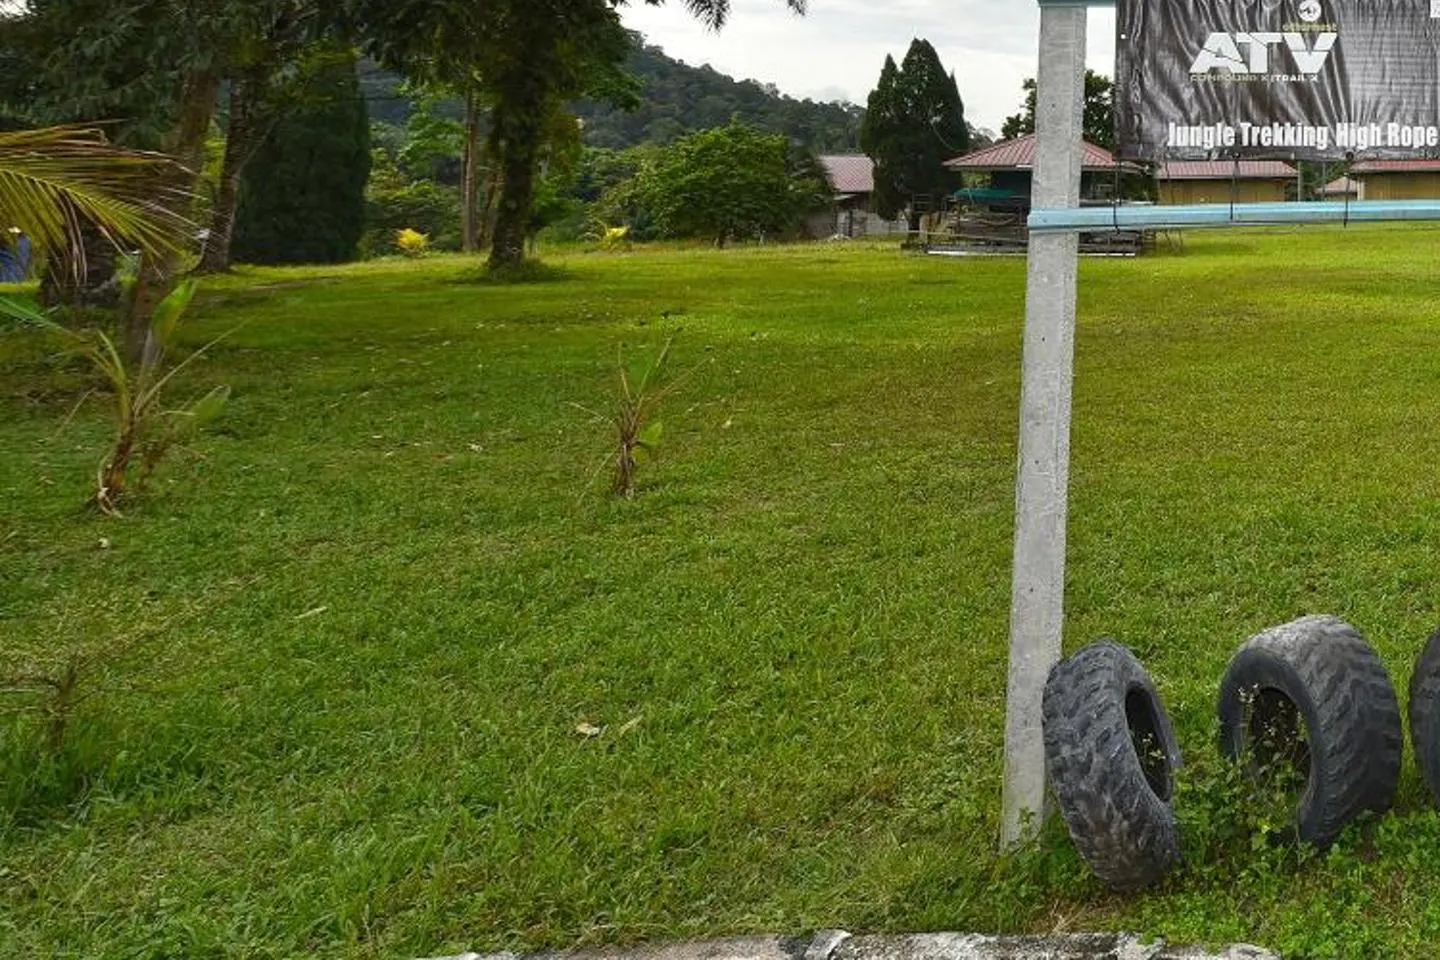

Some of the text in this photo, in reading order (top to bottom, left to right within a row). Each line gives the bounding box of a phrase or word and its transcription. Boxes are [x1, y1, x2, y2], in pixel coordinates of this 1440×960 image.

[1188, 32, 1338, 74] ATV
[1167, 123, 1235, 148] Jungle
[1240, 123, 1328, 148] Trekking
[1336, 124, 1382, 149] High
[1388, 124, 1438, 149] Rope
